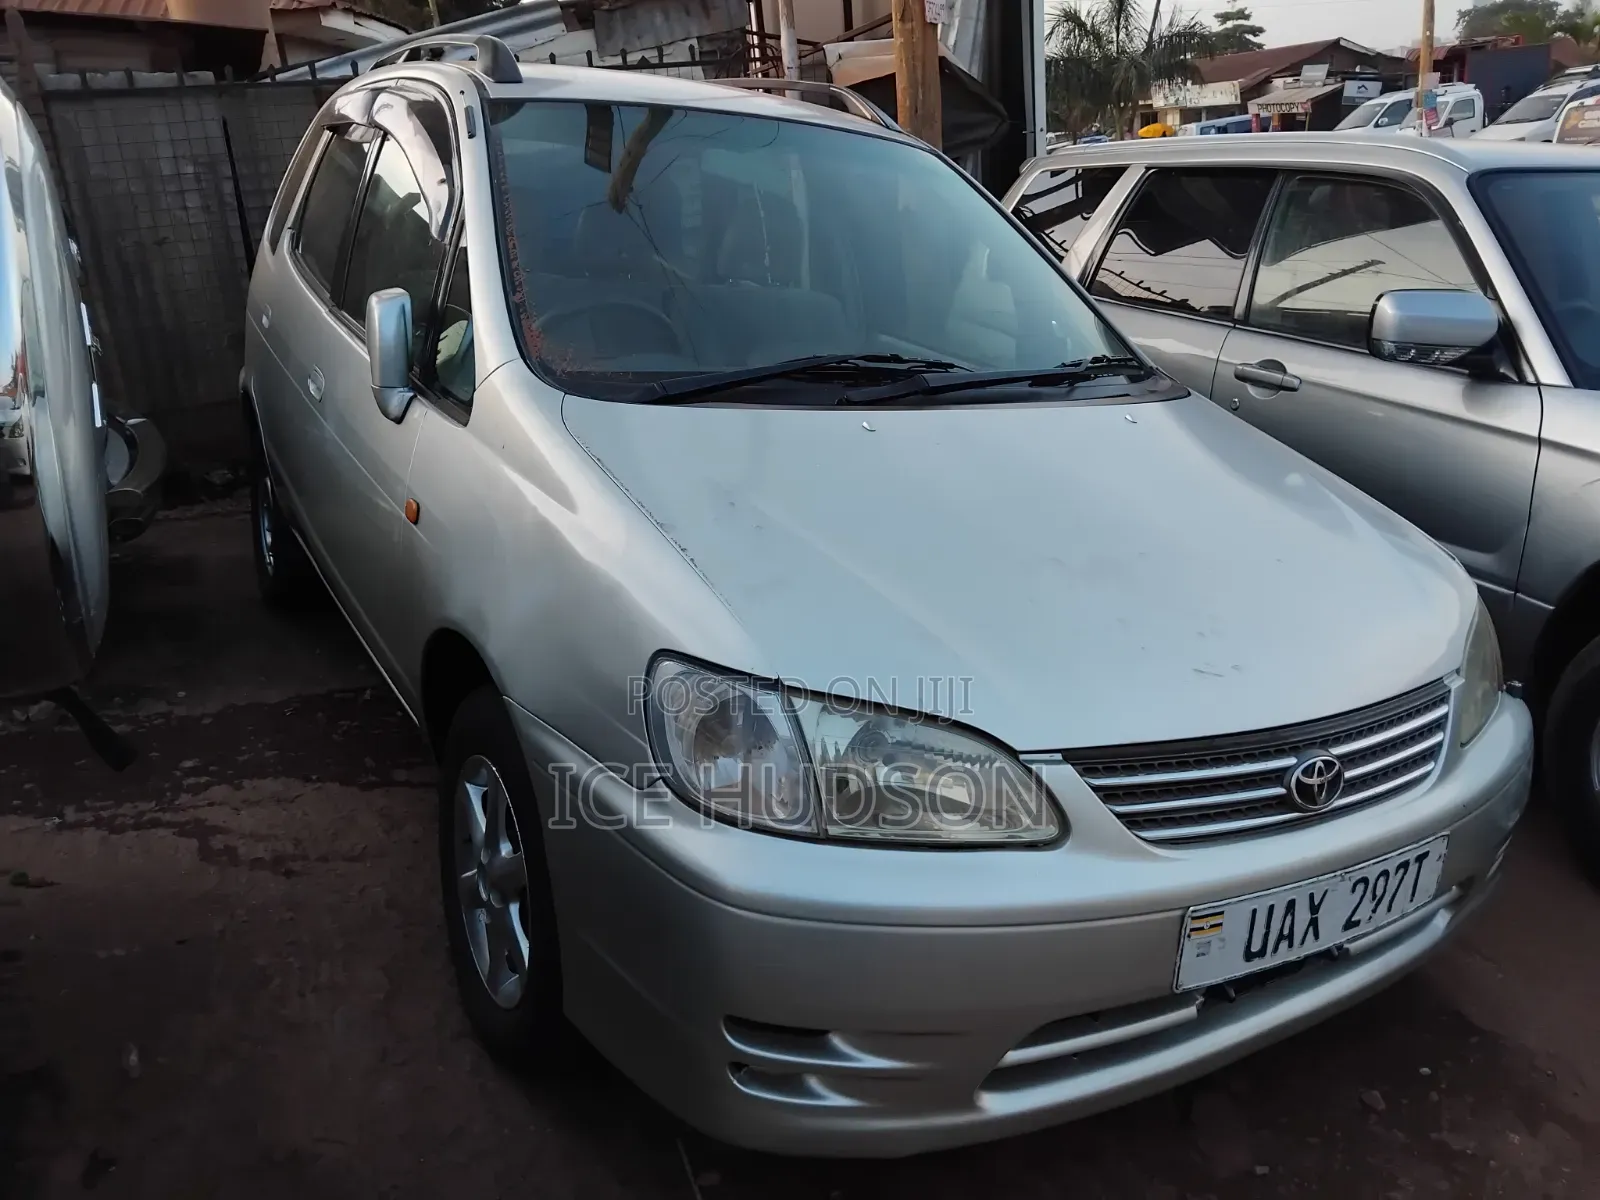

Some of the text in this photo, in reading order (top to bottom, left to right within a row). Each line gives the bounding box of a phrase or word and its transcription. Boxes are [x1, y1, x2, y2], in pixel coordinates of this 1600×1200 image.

[1257, 102, 1300, 113] PHOTOCOPY
[1243, 850, 1431, 963] UAX 297T
